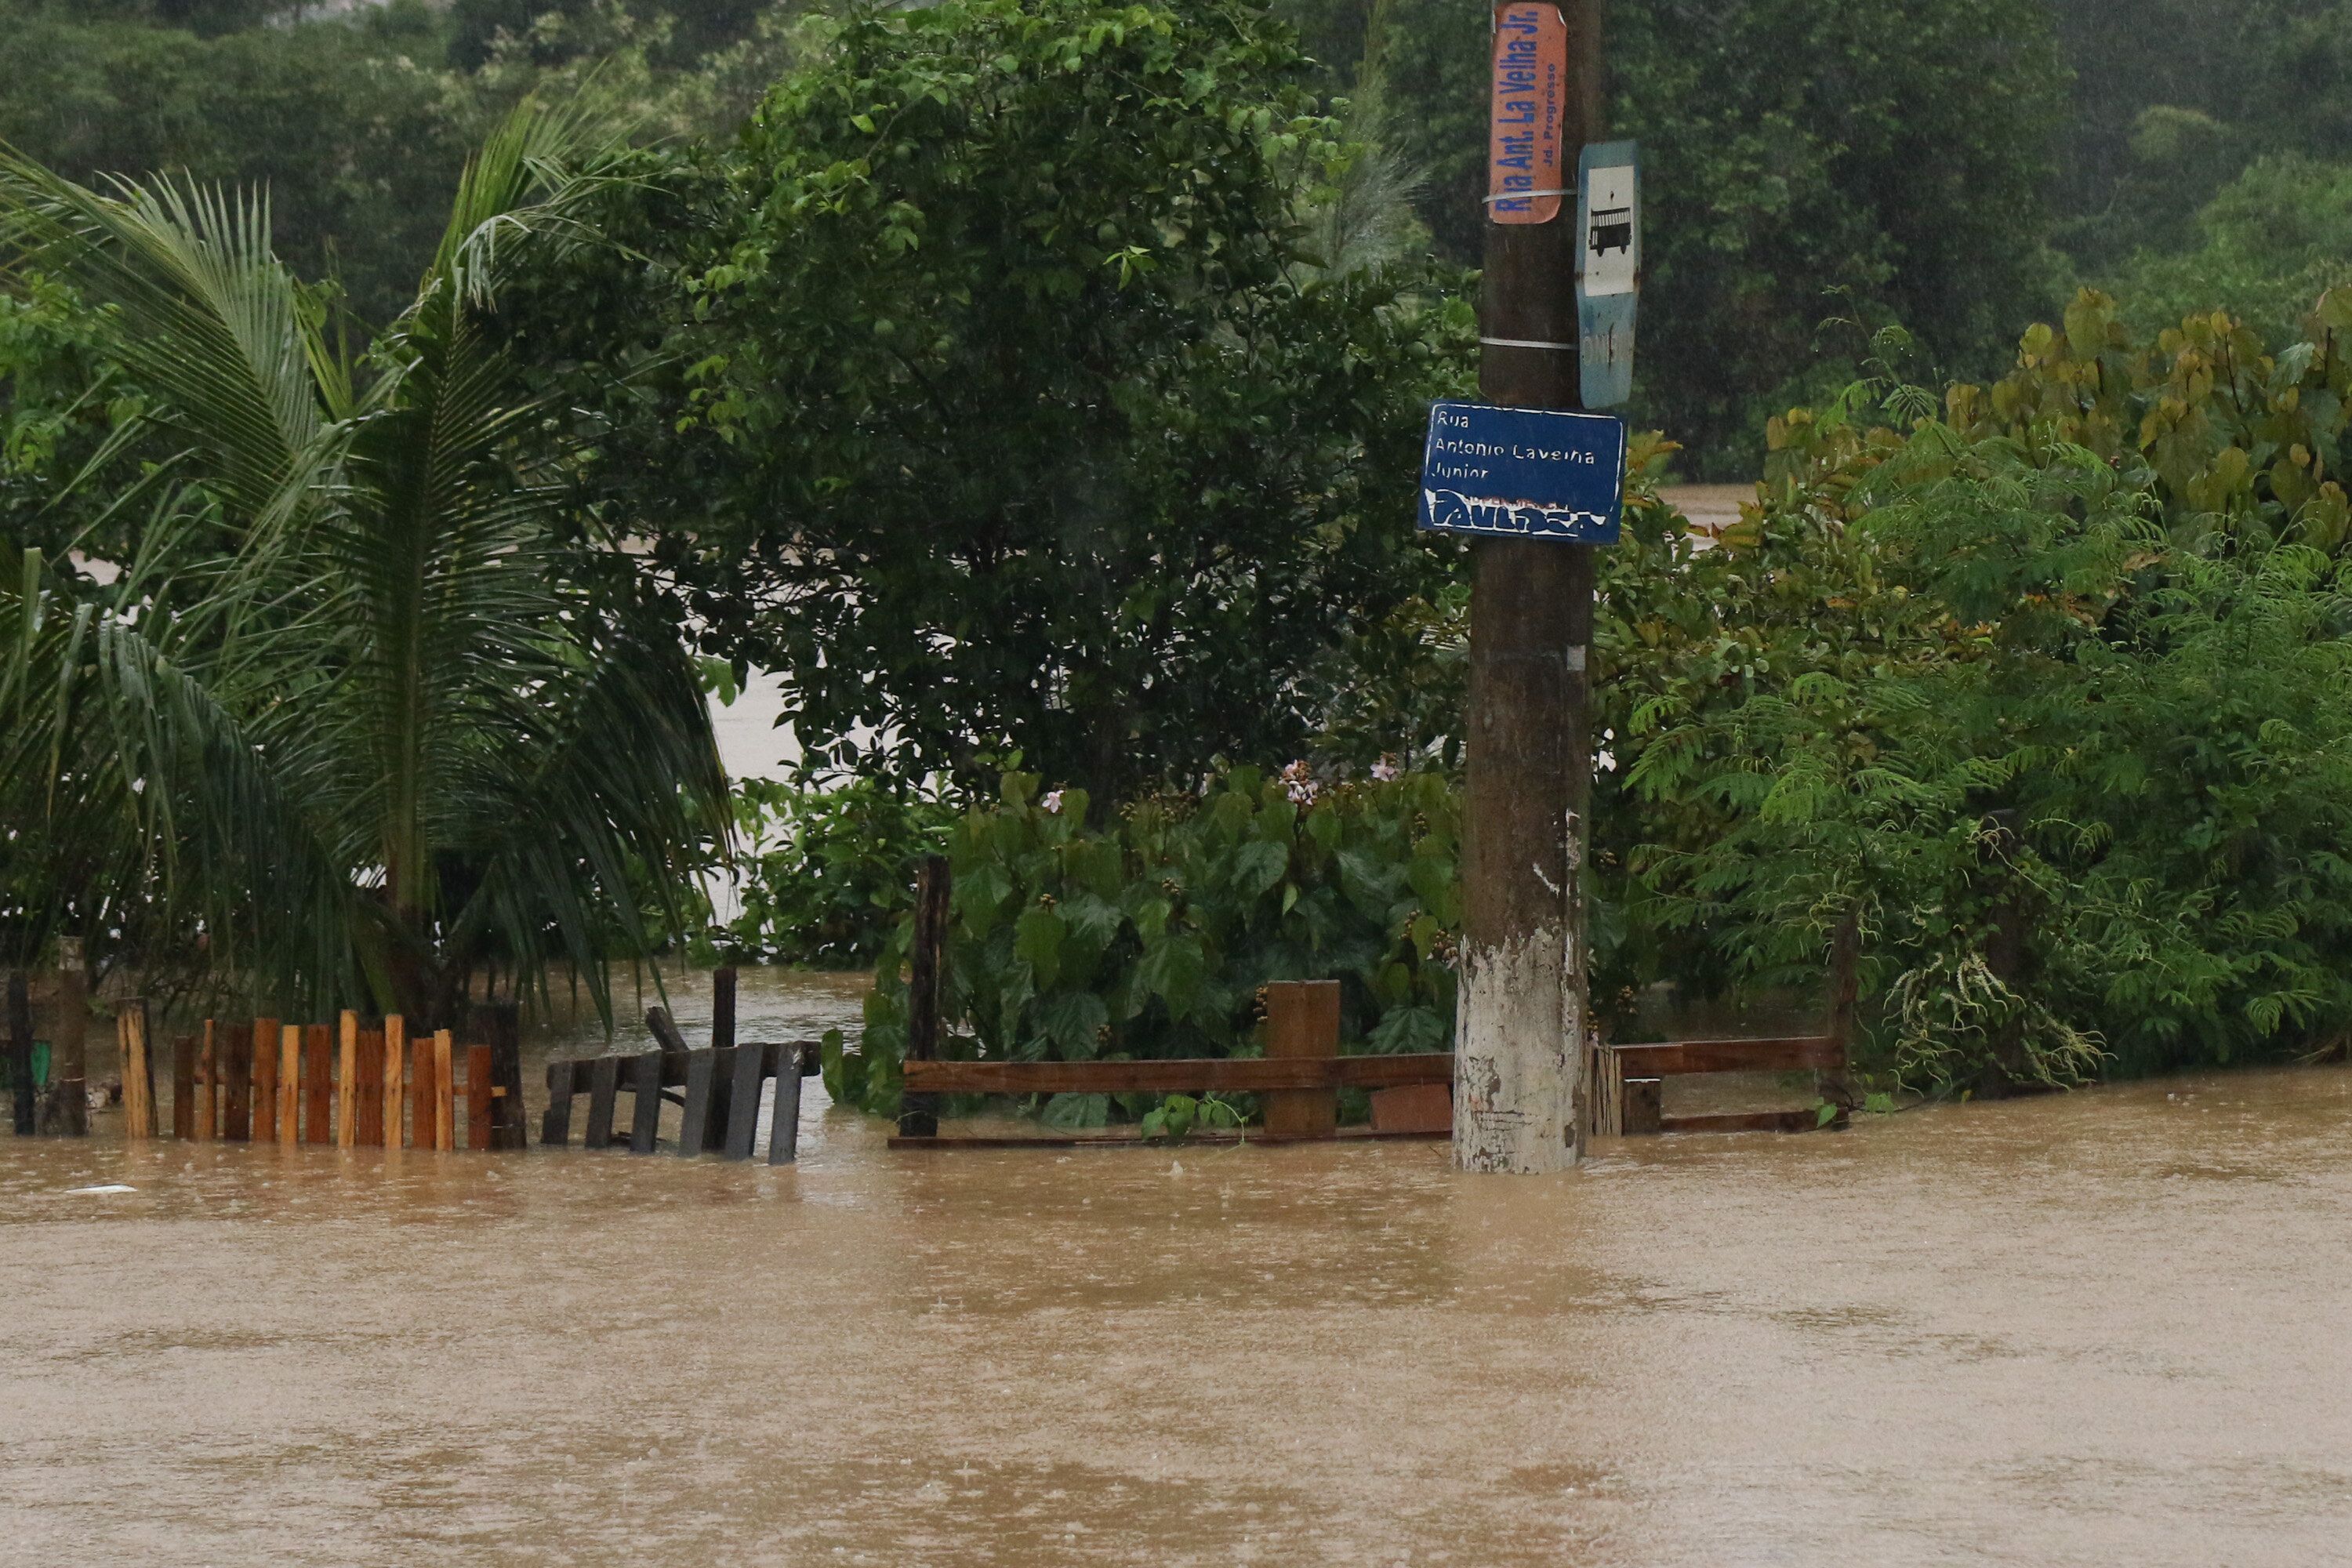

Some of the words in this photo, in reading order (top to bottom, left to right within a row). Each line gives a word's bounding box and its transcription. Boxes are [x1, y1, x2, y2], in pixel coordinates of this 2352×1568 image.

[1500, 11, 1539, 35] Jr.
[1499, 40, 1537, 95] Velha
[1498, 100, 1535, 123] La
[1544, 63, 1557, 140] Progresso
[1496, 131, 1534, 169] Ant.
[1543, 145, 1553, 167] Jd.
[1495, 174, 1534, 212] Rua
[1437, 411, 1469, 428] Rua
[1436, 437, 1504, 456] Antonio
[1432, 463, 1489, 478] Junior
